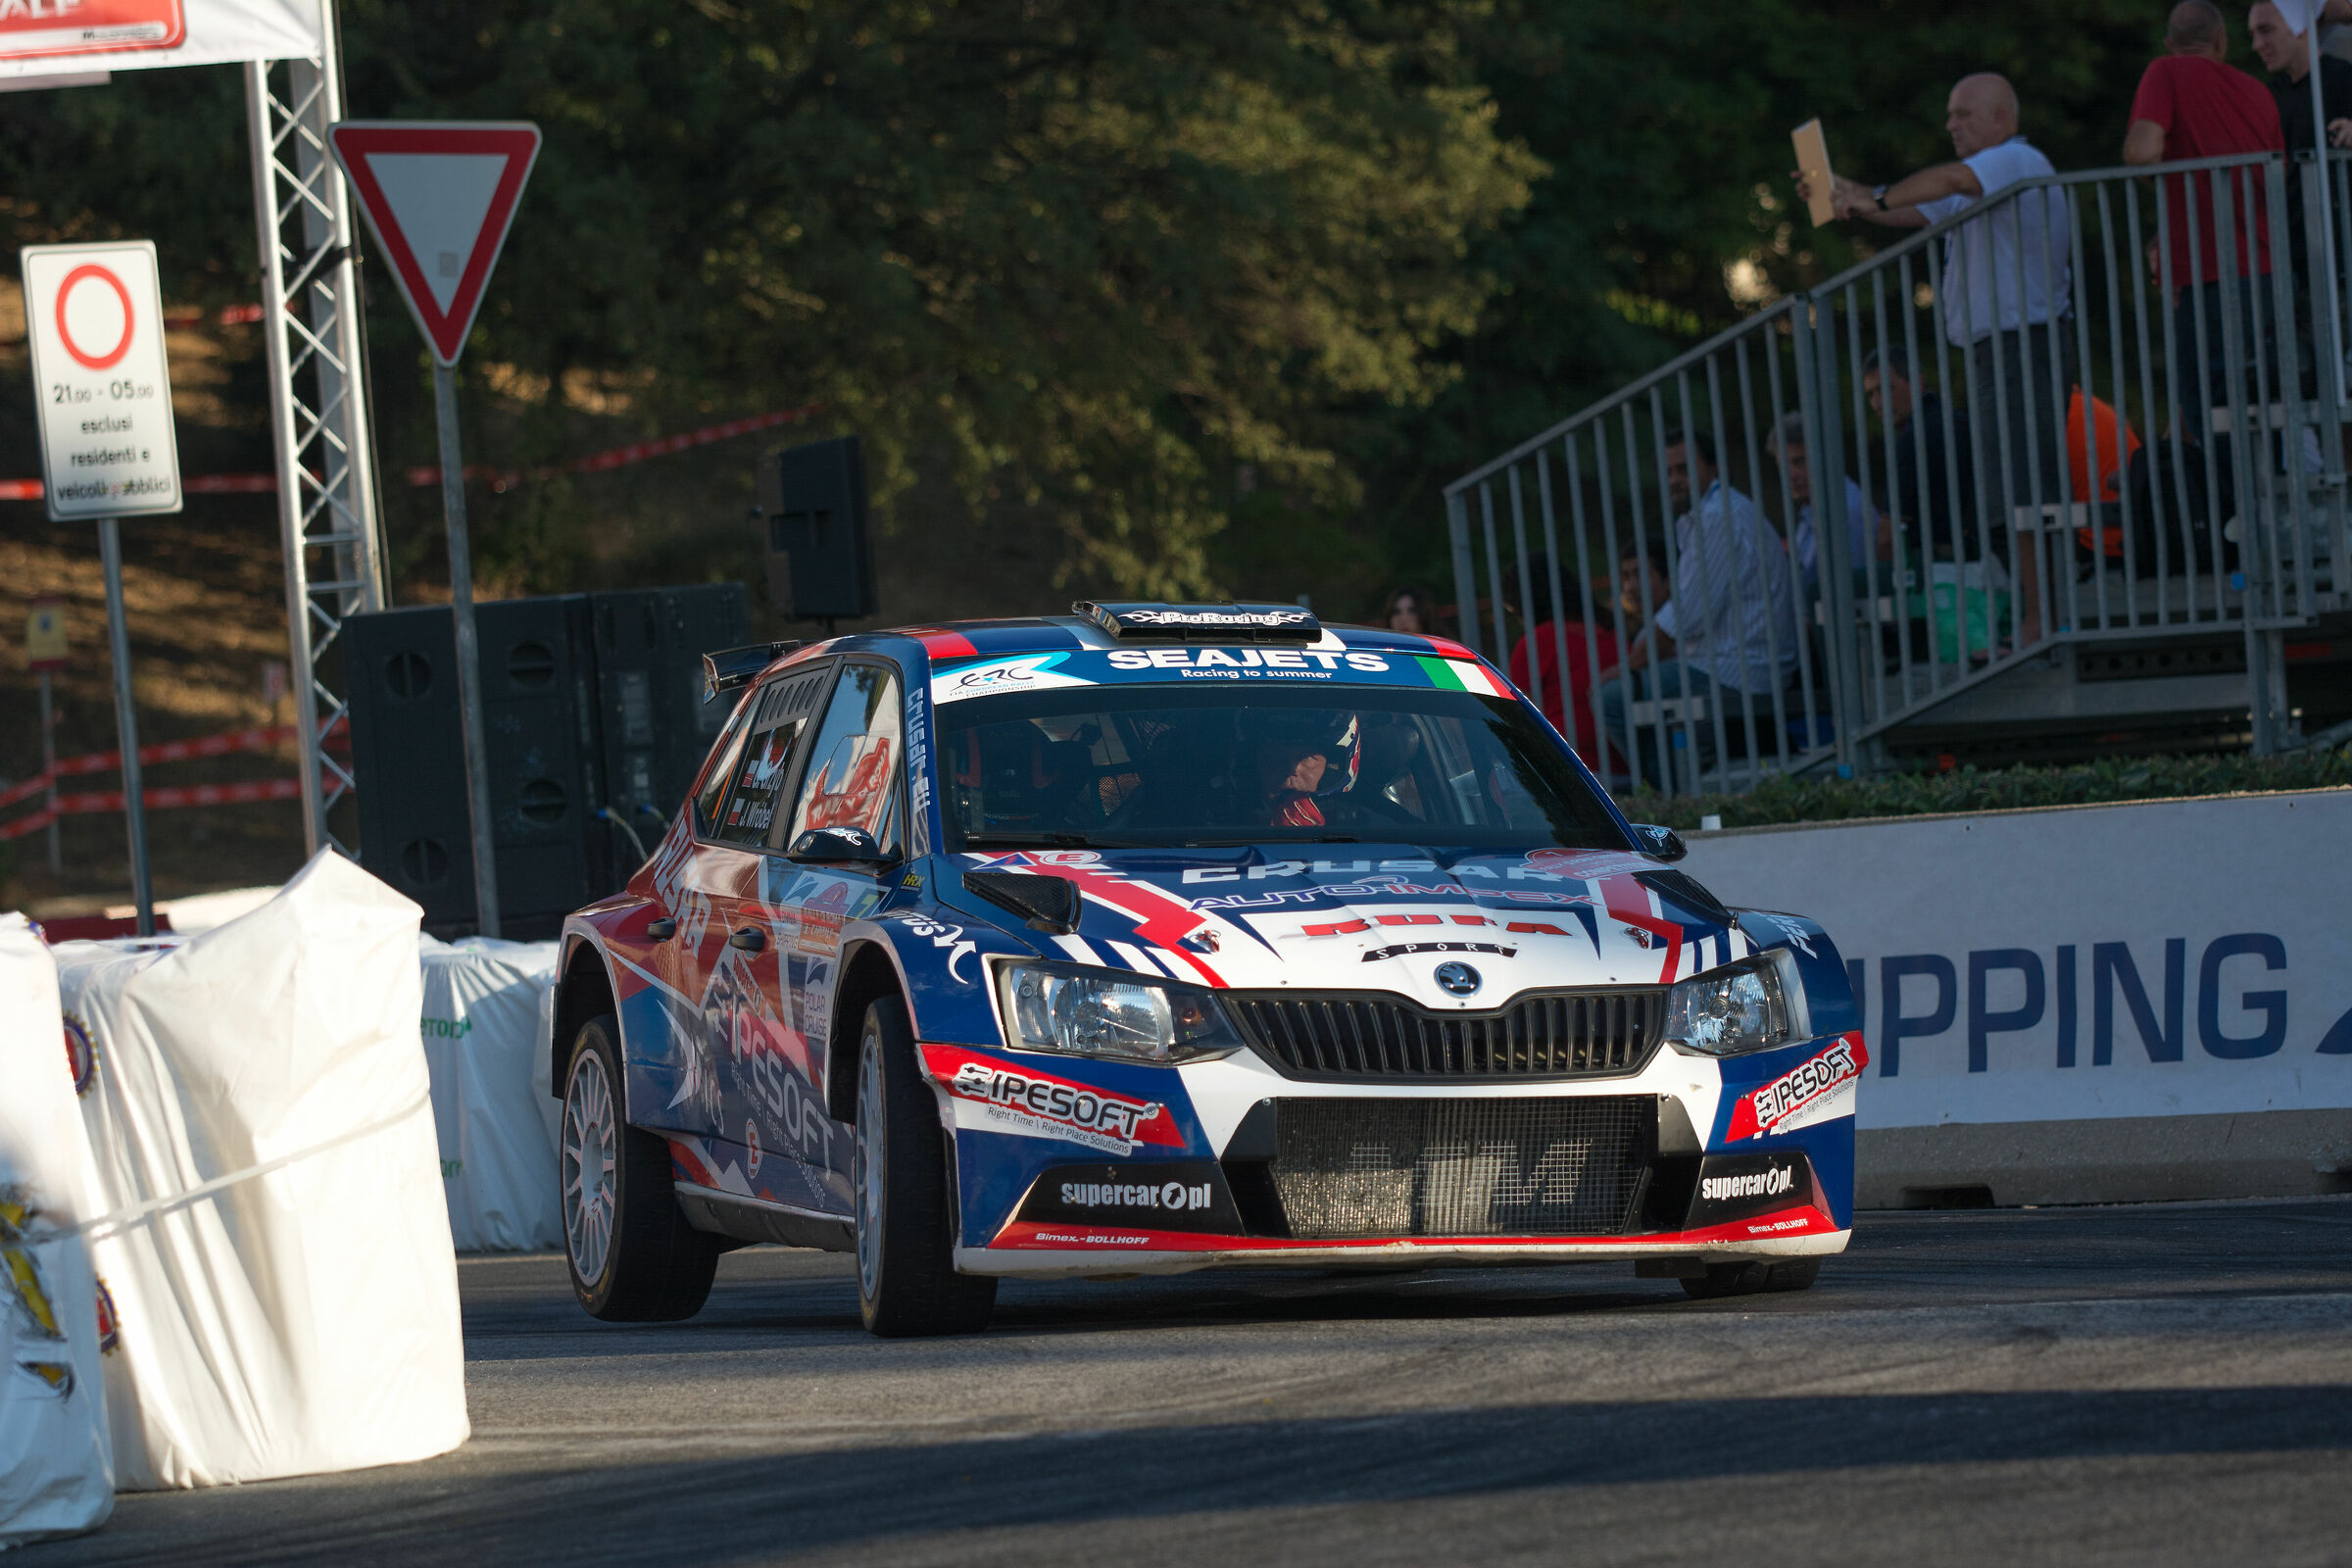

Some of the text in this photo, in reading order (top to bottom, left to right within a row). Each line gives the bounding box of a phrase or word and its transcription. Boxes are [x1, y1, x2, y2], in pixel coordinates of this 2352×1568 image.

[80, 415, 133, 433] esclusi
[71, 447, 150, 466] residenti e
[1160, 612, 1282, 625] ProRacing
[1106, 649, 1390, 672] SEAJETS
[1180, 668, 1333, 679] Racing to summer
[903, 873, 925, 887] HRX
[1182, 859, 1565, 884] CRUSAR
[1376, 942, 1505, 959] SPORT
[805, 992, 825, 1013] POLAR
[805, 1016, 827, 1037] CRUISE
[988, 1106, 1010, 1122] Right
[1012, 1112, 1034, 1127] Time
[1042, 1122, 1065, 1138] Right
[1066, 1127, 1088, 1142] Place
[1090, 1133, 1129, 1153] Solutions
